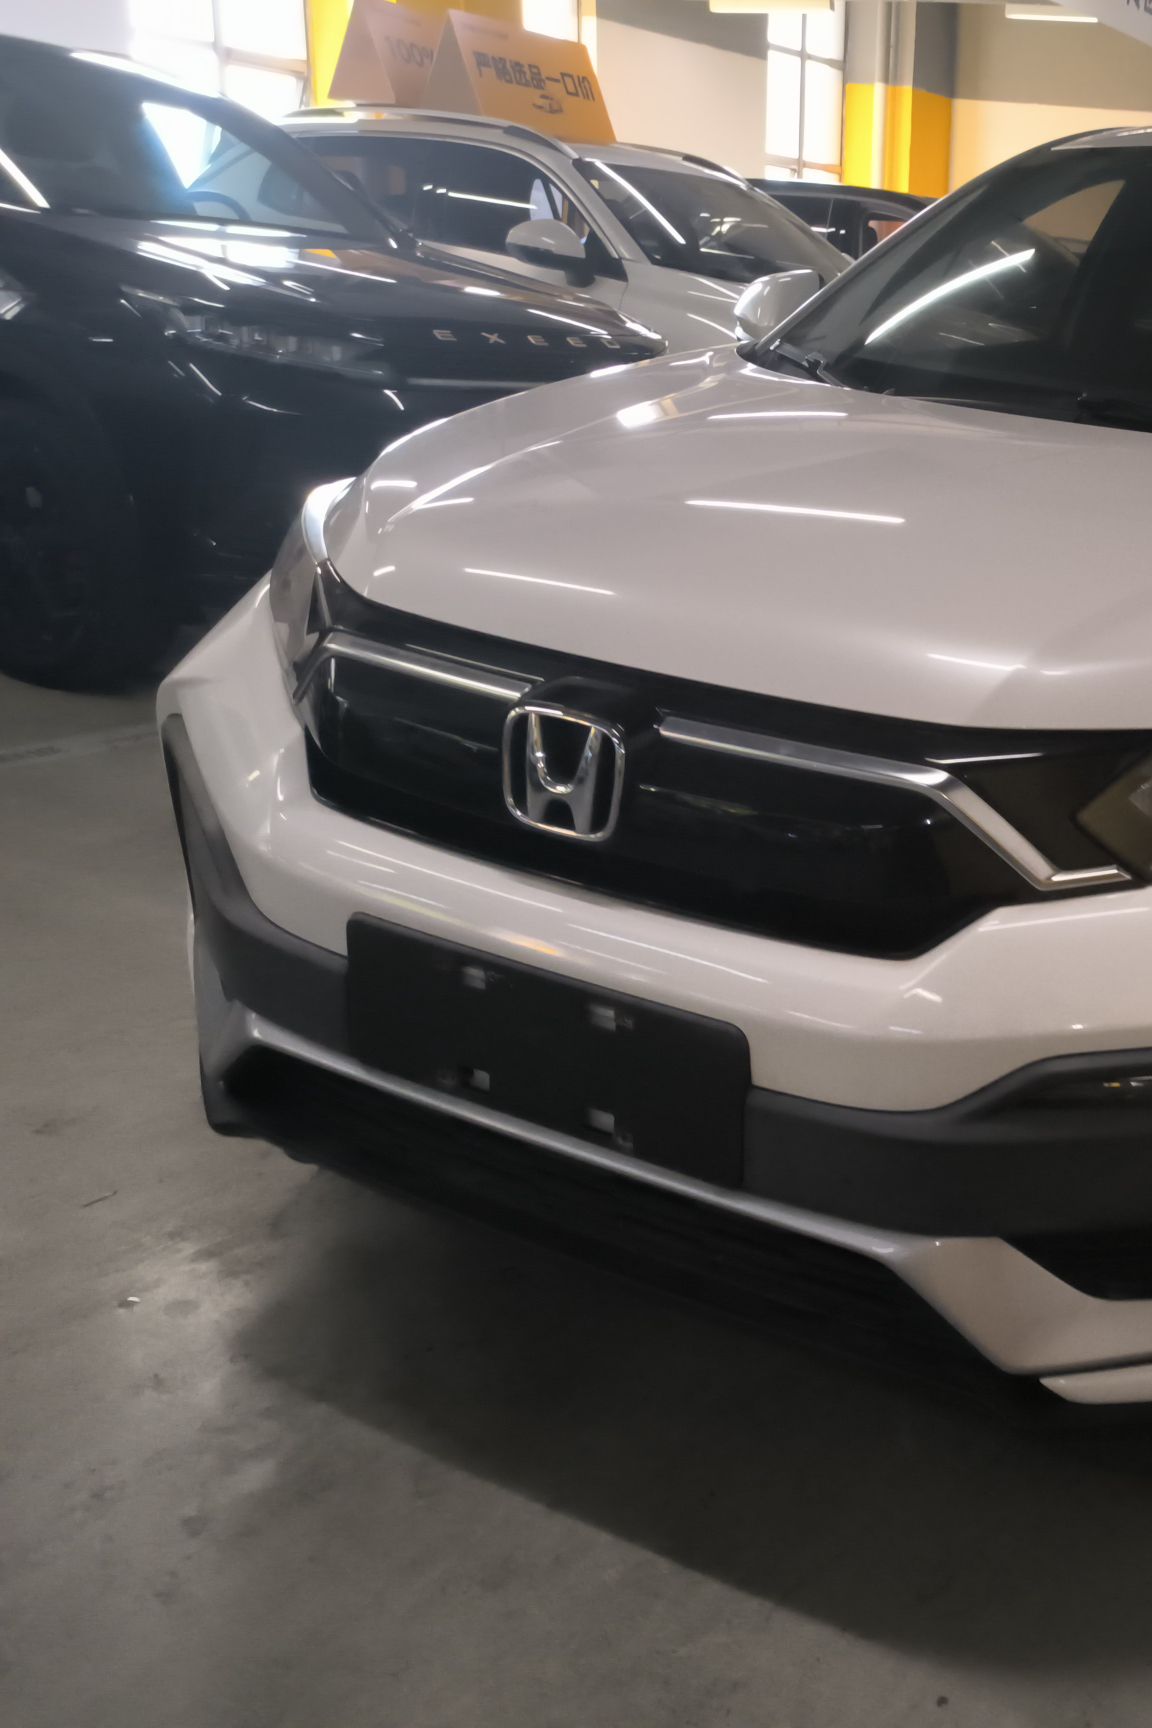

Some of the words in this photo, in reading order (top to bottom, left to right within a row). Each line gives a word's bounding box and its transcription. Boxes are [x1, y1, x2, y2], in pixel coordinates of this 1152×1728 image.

[472, 51, 596, 102] 严格选品一口价
[432, 329, 620, 349] EXEED
